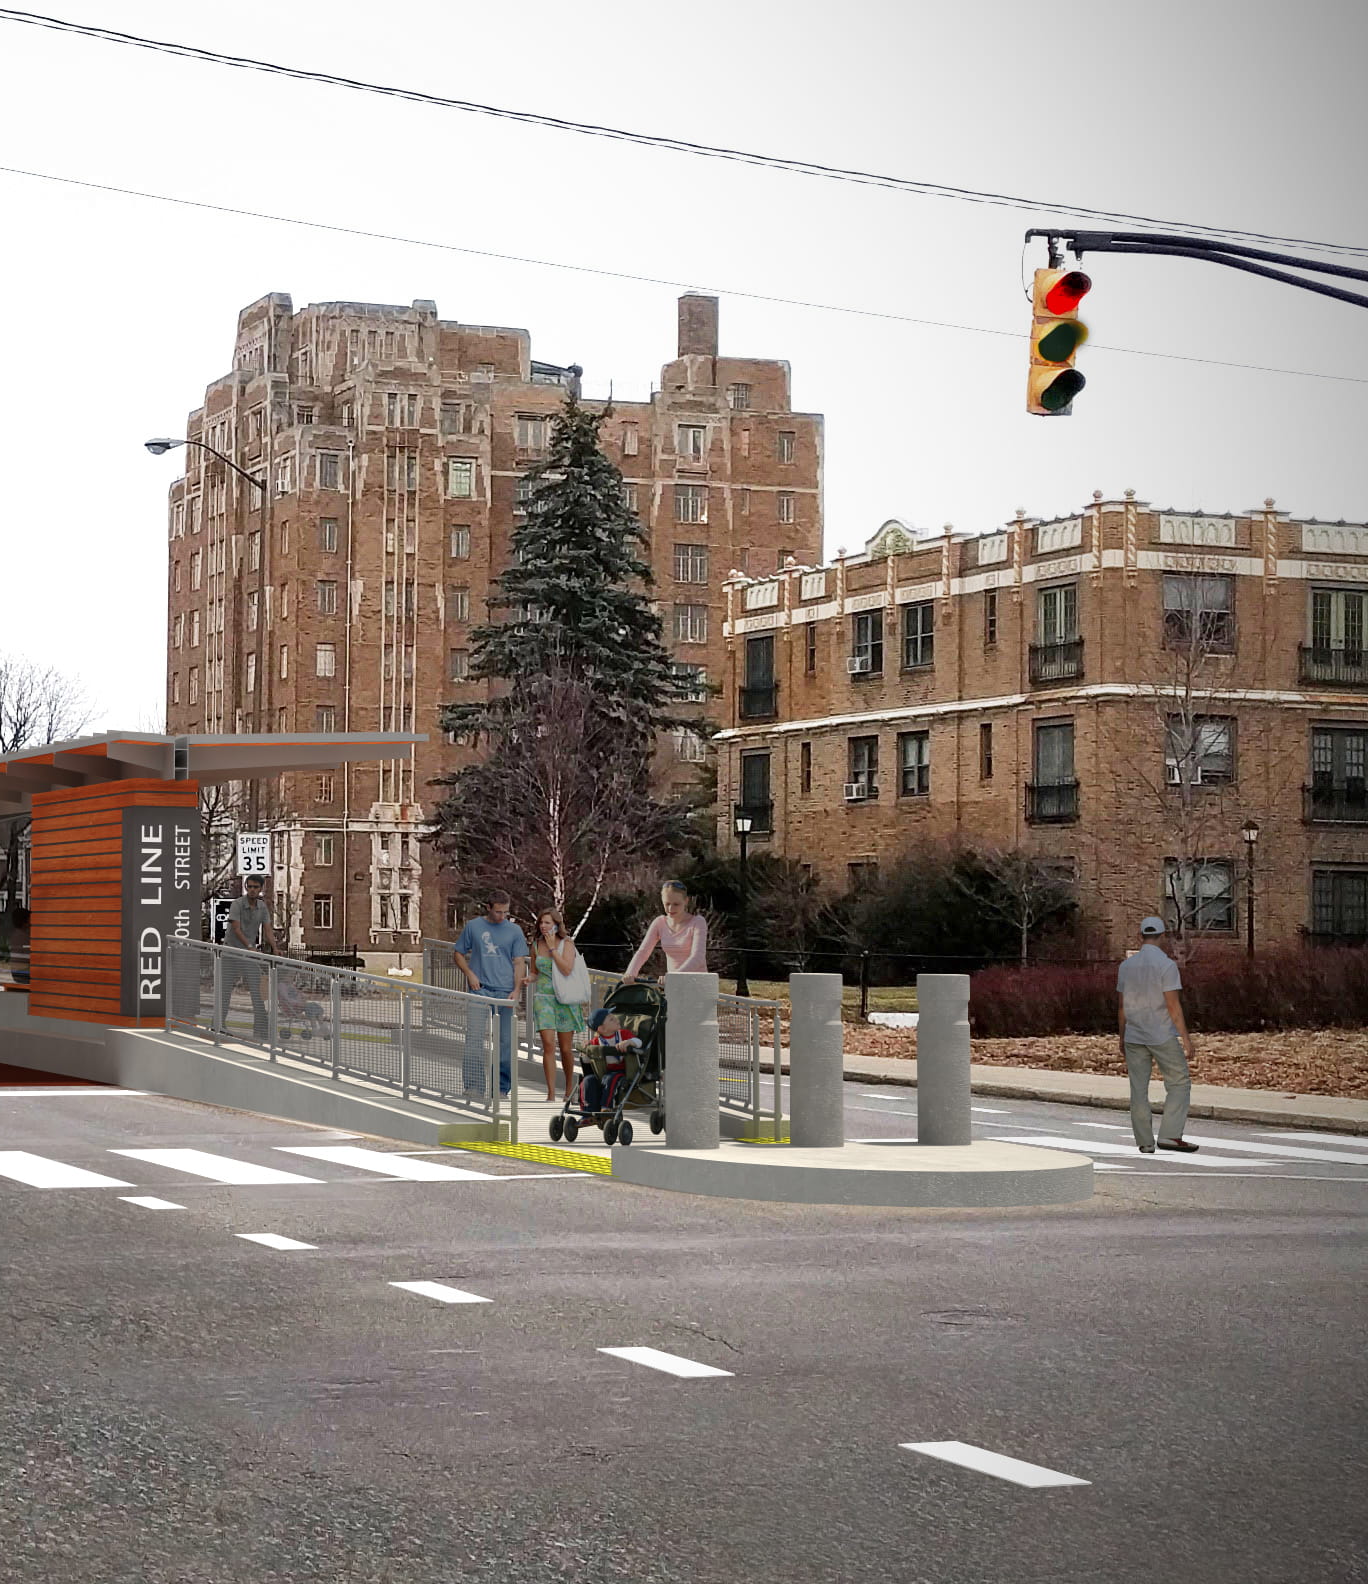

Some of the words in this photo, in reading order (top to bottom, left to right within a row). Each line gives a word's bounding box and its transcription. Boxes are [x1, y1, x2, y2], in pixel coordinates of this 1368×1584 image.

[240, 837, 268, 845] SPEED
[242, 846, 266, 854] LIMIT
[140, 824, 163, 905] LINE
[174, 824, 191, 890] STREET
[243, 856, 266, 871] 35
[173, 909, 190, 940] 0th
[140, 927, 162, 1000] RED
